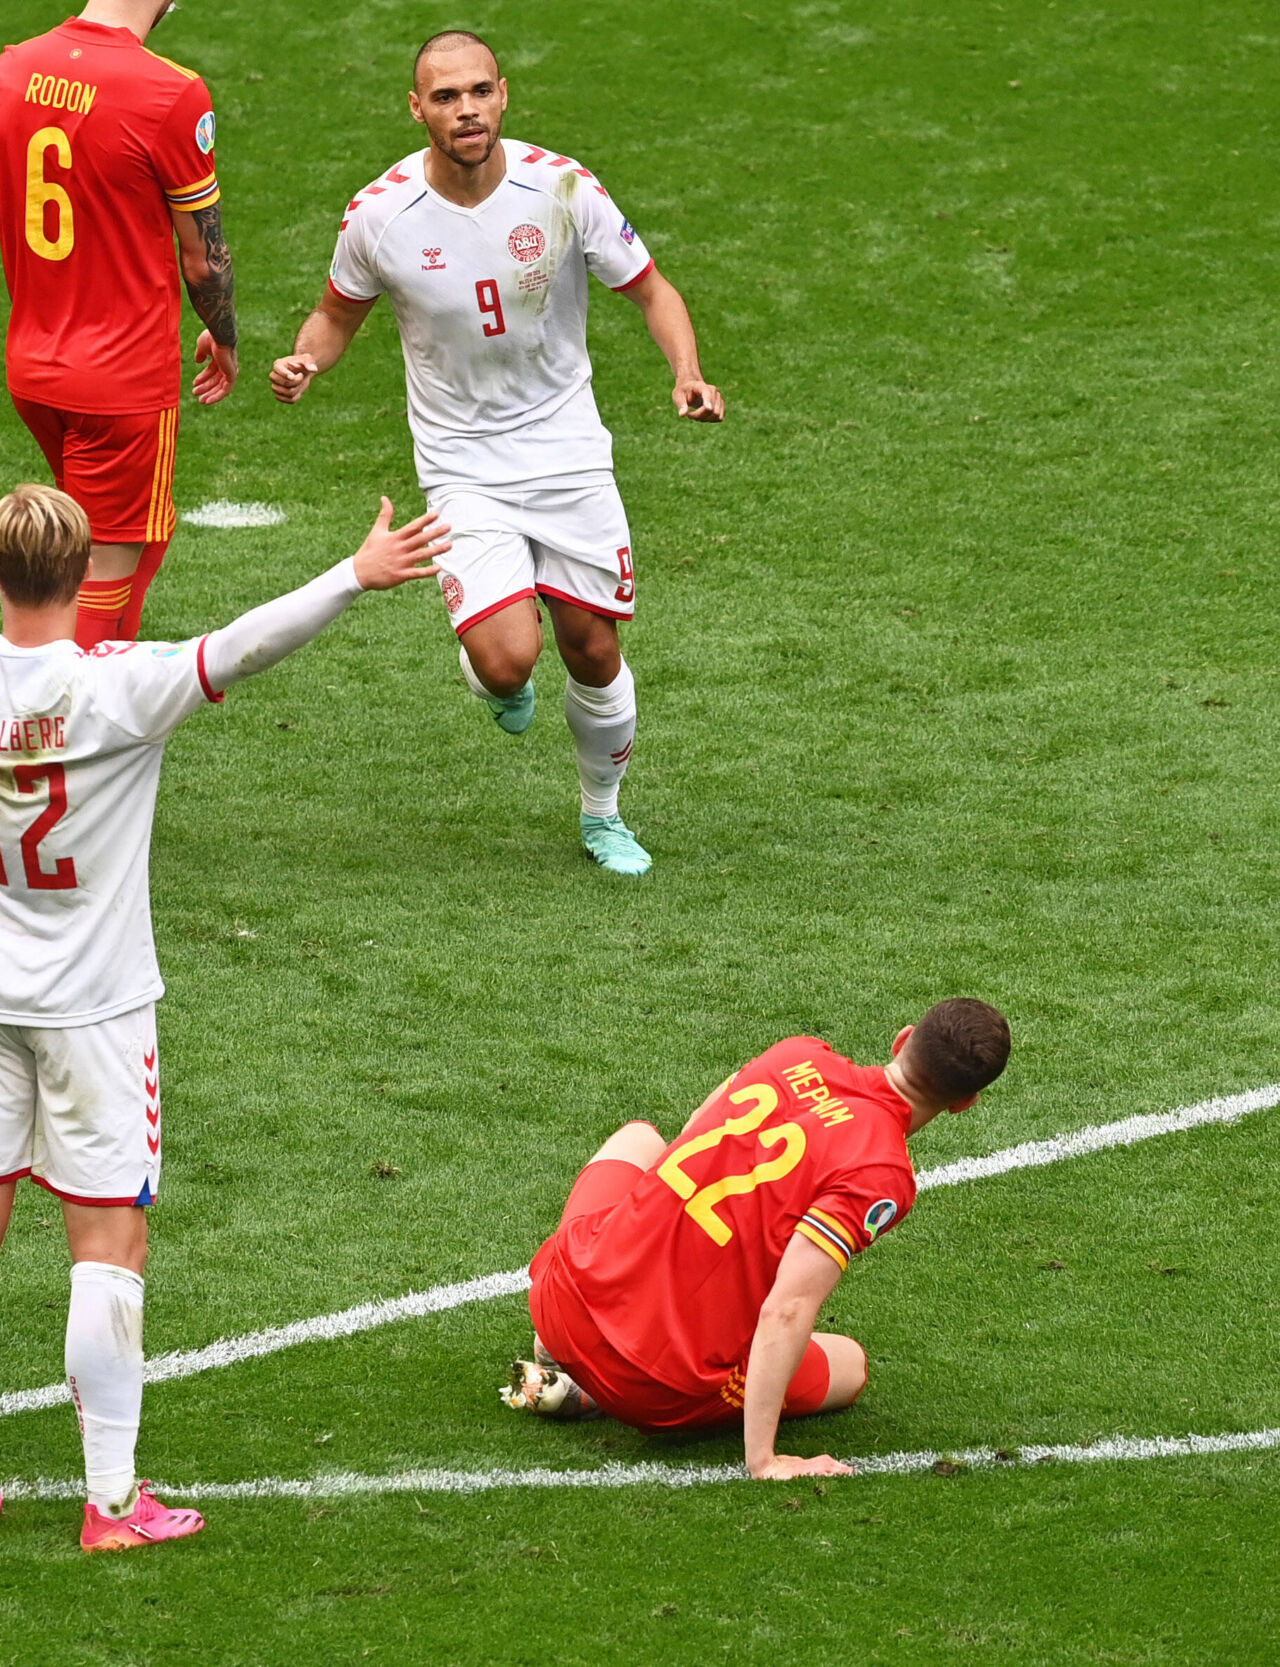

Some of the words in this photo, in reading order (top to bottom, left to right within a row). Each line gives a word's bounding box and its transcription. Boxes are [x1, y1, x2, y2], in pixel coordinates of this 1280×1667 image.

[24, 72, 97, 115] RODON
[24, 126, 75, 261] 6
[514, 235, 539, 251] DBU
[475, 278, 506, 337] 9
[615, 546, 636, 603] 9
[657, 1082, 807, 1247] 22
